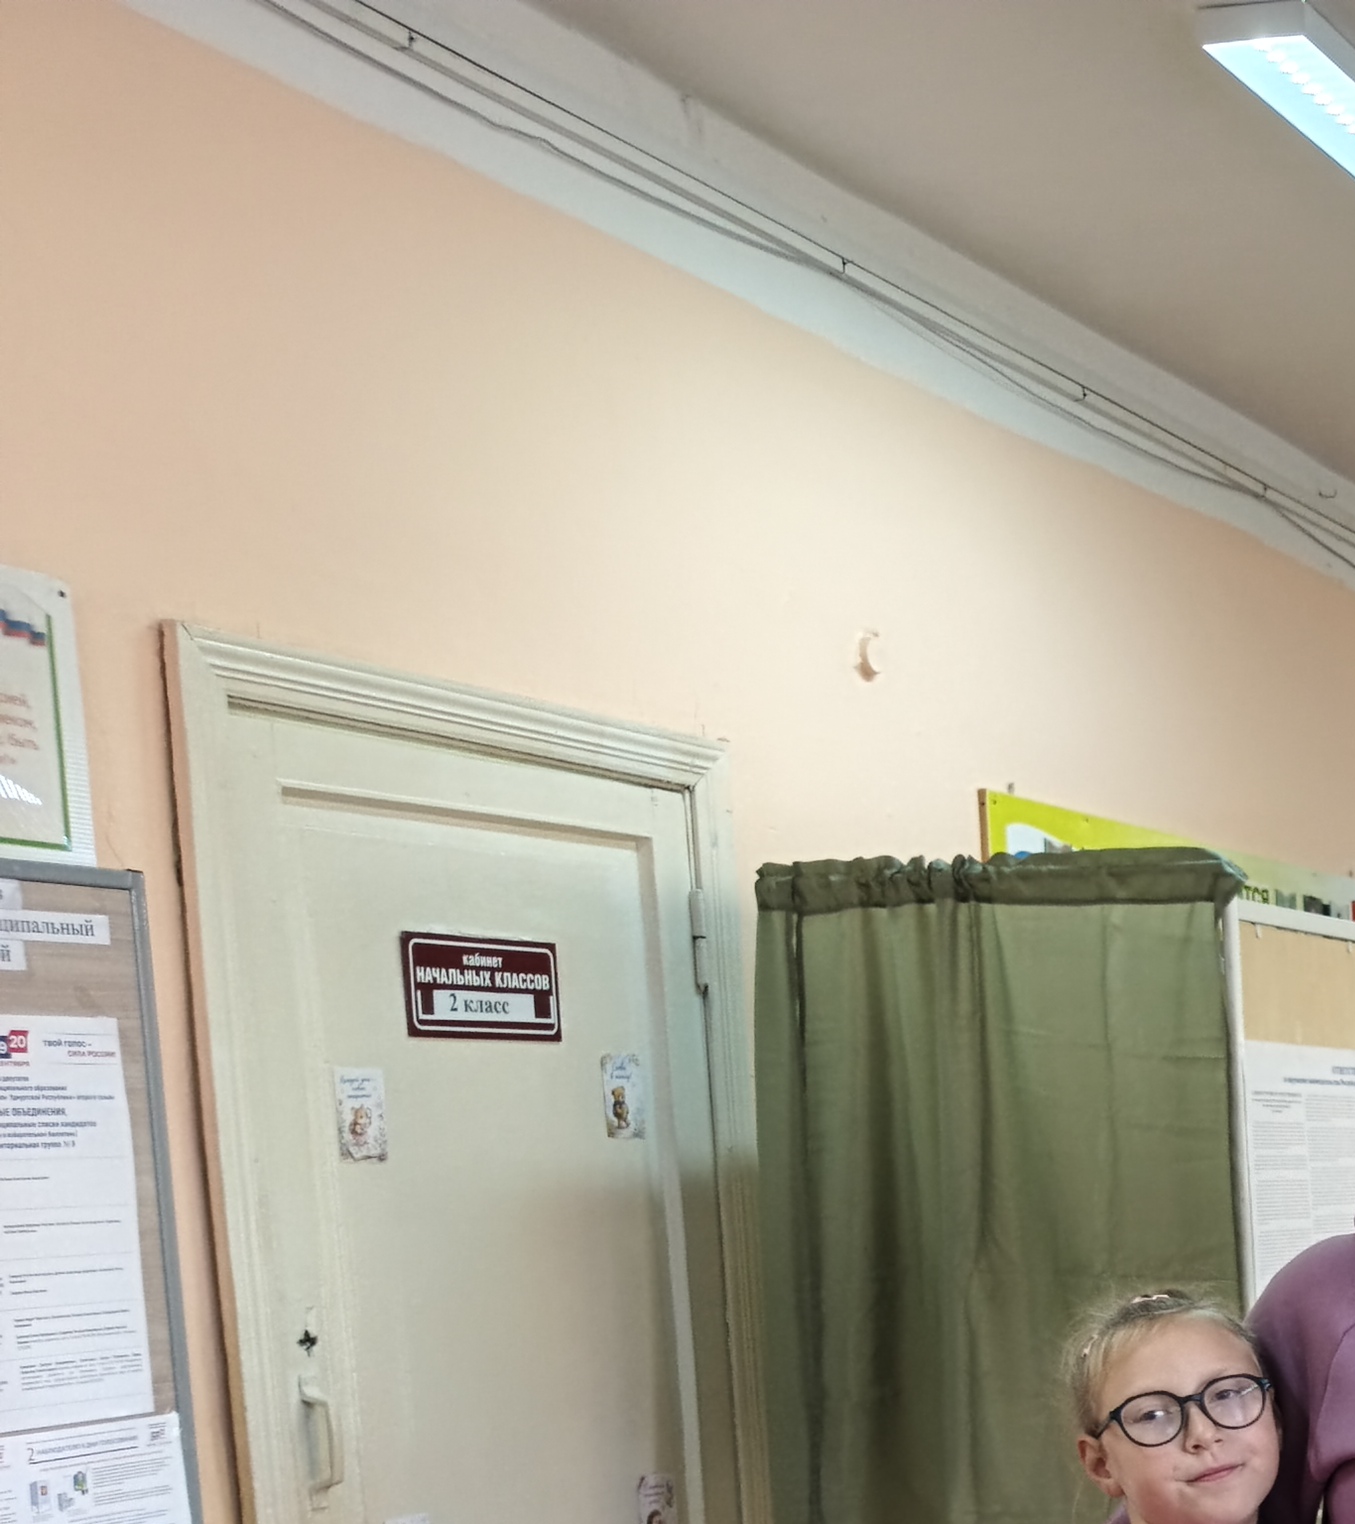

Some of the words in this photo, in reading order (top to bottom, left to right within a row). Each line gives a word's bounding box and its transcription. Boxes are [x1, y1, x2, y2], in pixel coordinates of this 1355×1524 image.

[462, 953, 503, 968] кабинет
[416, 966, 492, 987] НАЧАЛЬНЫХ
[494, 972, 550, 990] КЛАССОВ
[449, 993, 458, 1012] 2
[464, 999, 510, 1014] класс
[9, 1035, 26, 1049] 20
